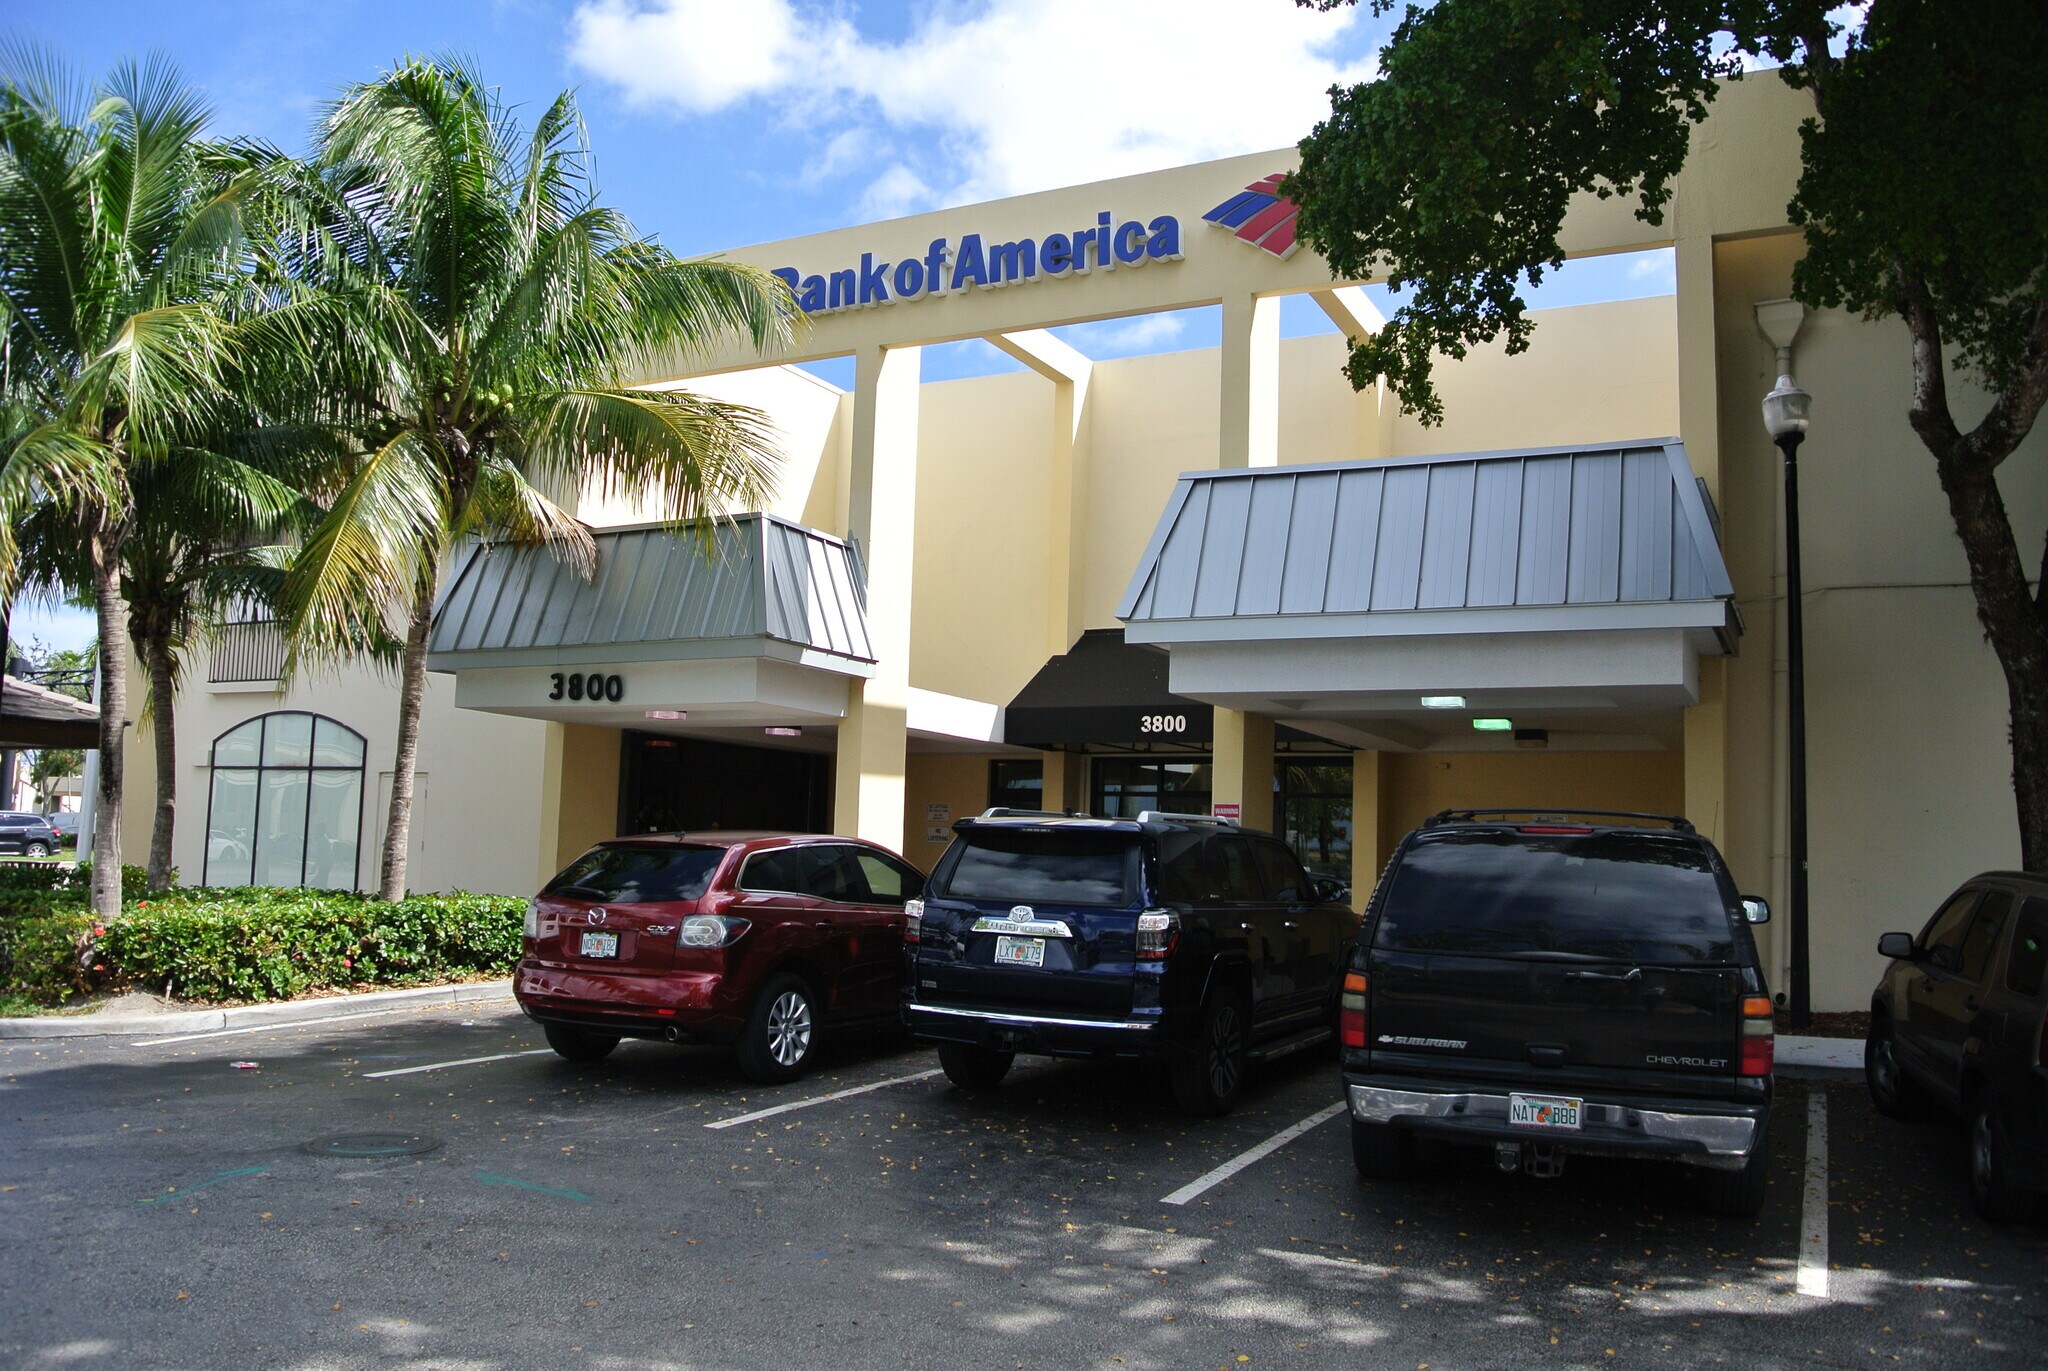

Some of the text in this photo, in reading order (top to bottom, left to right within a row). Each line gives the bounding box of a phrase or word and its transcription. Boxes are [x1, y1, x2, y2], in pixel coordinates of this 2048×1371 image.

[549, 672, 624, 703] 3800
[1140, 715, 1187, 733] 3800
[1215, 807, 1239, 815] WARNING
[1393, 1035, 1468, 1049] SUBURBAN
[1646, 1055, 1729, 1068] CHEVROLET
[1512, 1104, 1537, 1123] NAT
